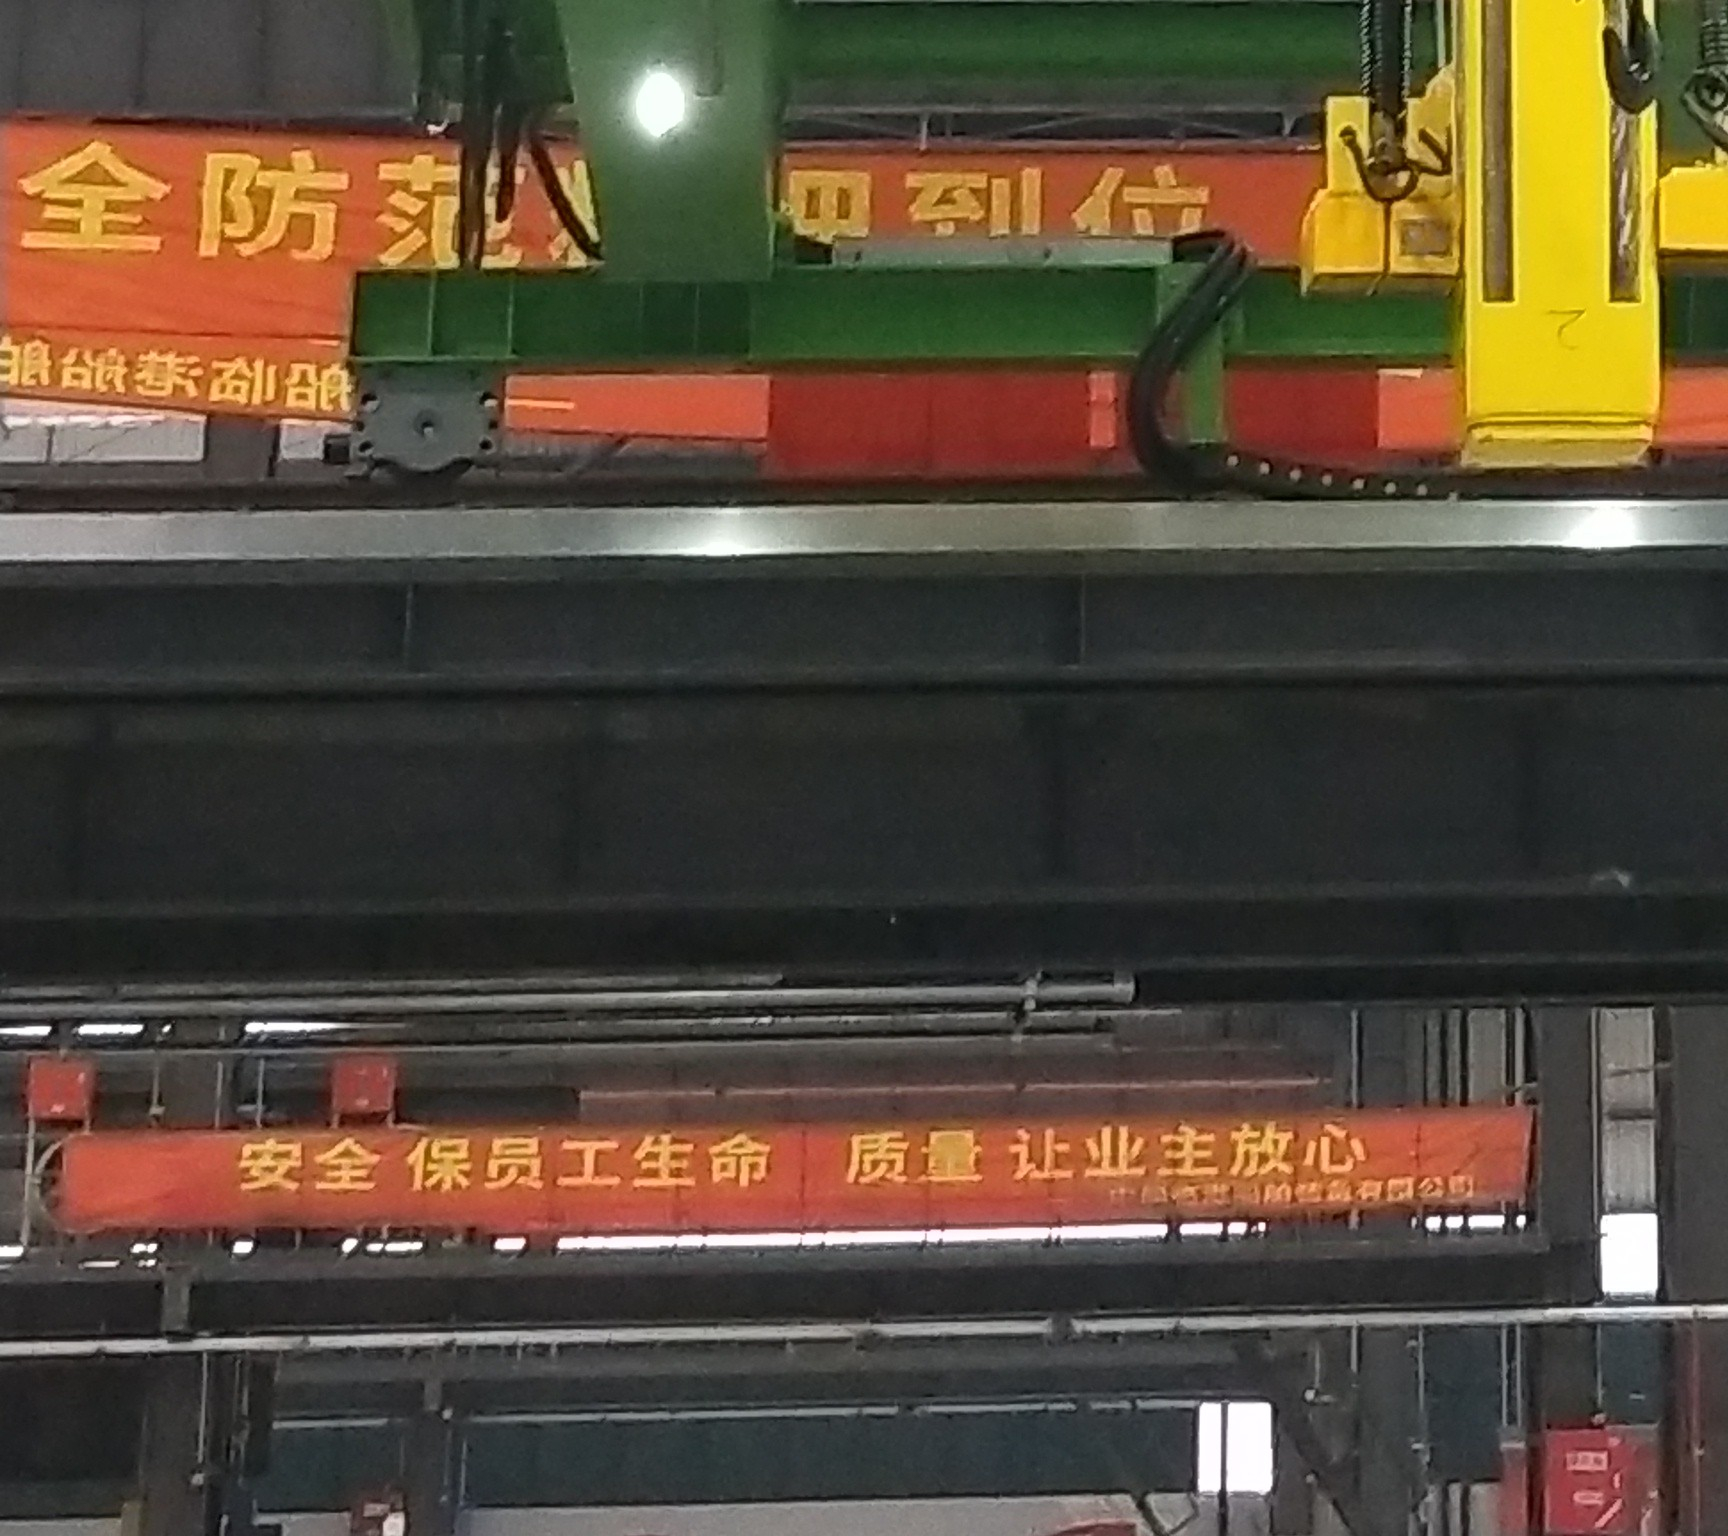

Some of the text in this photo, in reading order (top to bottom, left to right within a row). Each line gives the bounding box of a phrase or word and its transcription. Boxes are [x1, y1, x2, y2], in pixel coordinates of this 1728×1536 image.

[18, 138, 603, 270] 全防范
[237, 1121, 1368, 1192] 安全 保员工生命 质量 让业主放心
